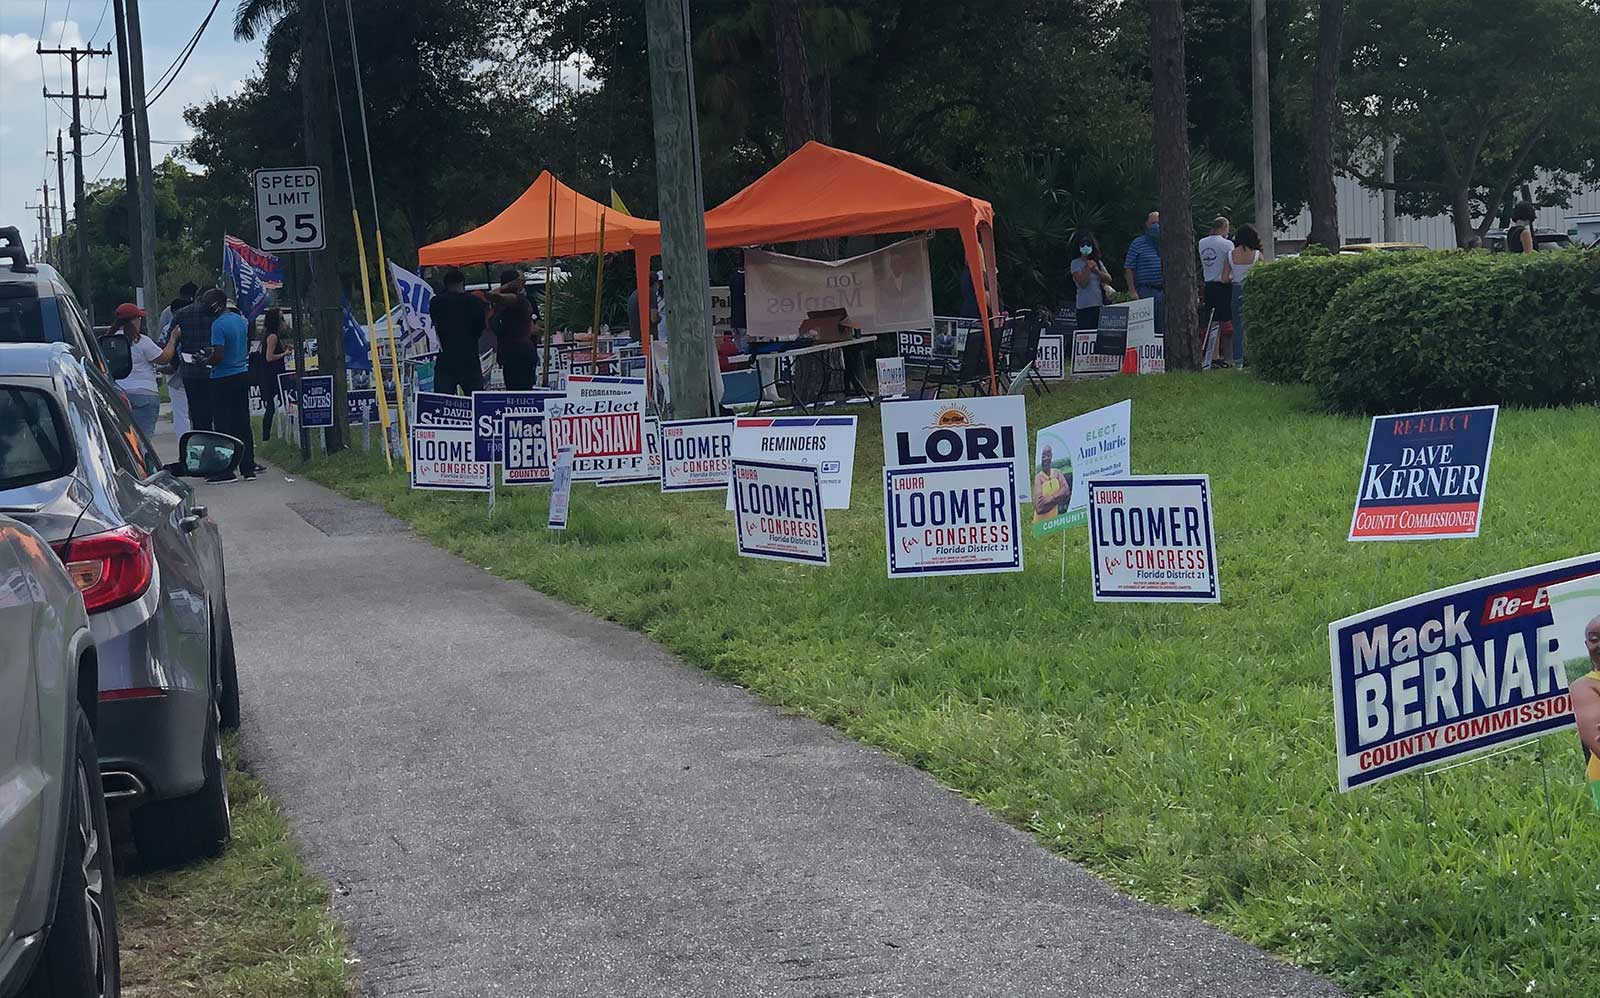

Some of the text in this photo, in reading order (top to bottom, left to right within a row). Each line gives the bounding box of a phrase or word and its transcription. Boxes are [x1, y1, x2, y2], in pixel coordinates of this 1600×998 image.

[261, 175, 316, 189] SPEED
[268, 193, 310, 206] LIMIT
[264, 214, 318, 244] 35
[712, 295, 730, 308] Pal
[900, 344, 932, 356] HARR
[1034, 346, 1058, 361] MER
[1076, 342, 1096, 356] LOO
[1140, 344, 1162, 359] LOOM
[442, 407, 472, 418] DAVID
[564, 400, 639, 415] Re-Elect
[509, 420, 545, 438] Mac
[551, 414, 638, 455] BRADSHAW
[664, 428, 684, 436] LAURA
[1086, 423, 1117, 442] ELECT
[1393, 414, 1472, 436] RE-ELECT
[417, 440, 472, 462] LOOME
[666, 434, 732, 461] LOOMER
[762, 436, 826, 452] REMINDERS
[896, 426, 1016, 466] LORI
[1099, 434, 1126, 454] Marie
[1400, 444, 1454, 468] DAVE
[434, 462, 485, 474] CONGRESS
[510, 470, 538, 478] COUNTY
[738, 468, 758, 481] LAURA
[894, 476, 924, 491] LAURA
[1362, 463, 1480, 500] KERNER
[738, 481, 816, 520] LOOMER
[1096, 490, 1124, 505] LAURA
[895, 487, 1006, 528] LOOMER
[746, 517, 818, 540] for CONGRESS
[1096, 506, 1202, 546] LOOMER
[1356, 510, 1476, 530] COUNTY COMMISSIONER
[769, 534, 790, 544] Florida
[790, 536, 812, 546] District
[902, 525, 1010, 554] for CONGRESS
[936, 544, 1009, 556] Florida District 21
[1104, 550, 1205, 576] for CONGRESS
[1136, 570, 1165, 579] Florida
[1166, 570, 1195, 579] District
[1488, 586, 1550, 620] Re-E
[1352, 604, 1473, 676] Mack
[1355, 622, 1569, 747] BERNAR
[1359, 694, 1573, 770] COUNTY COMMISSIO
